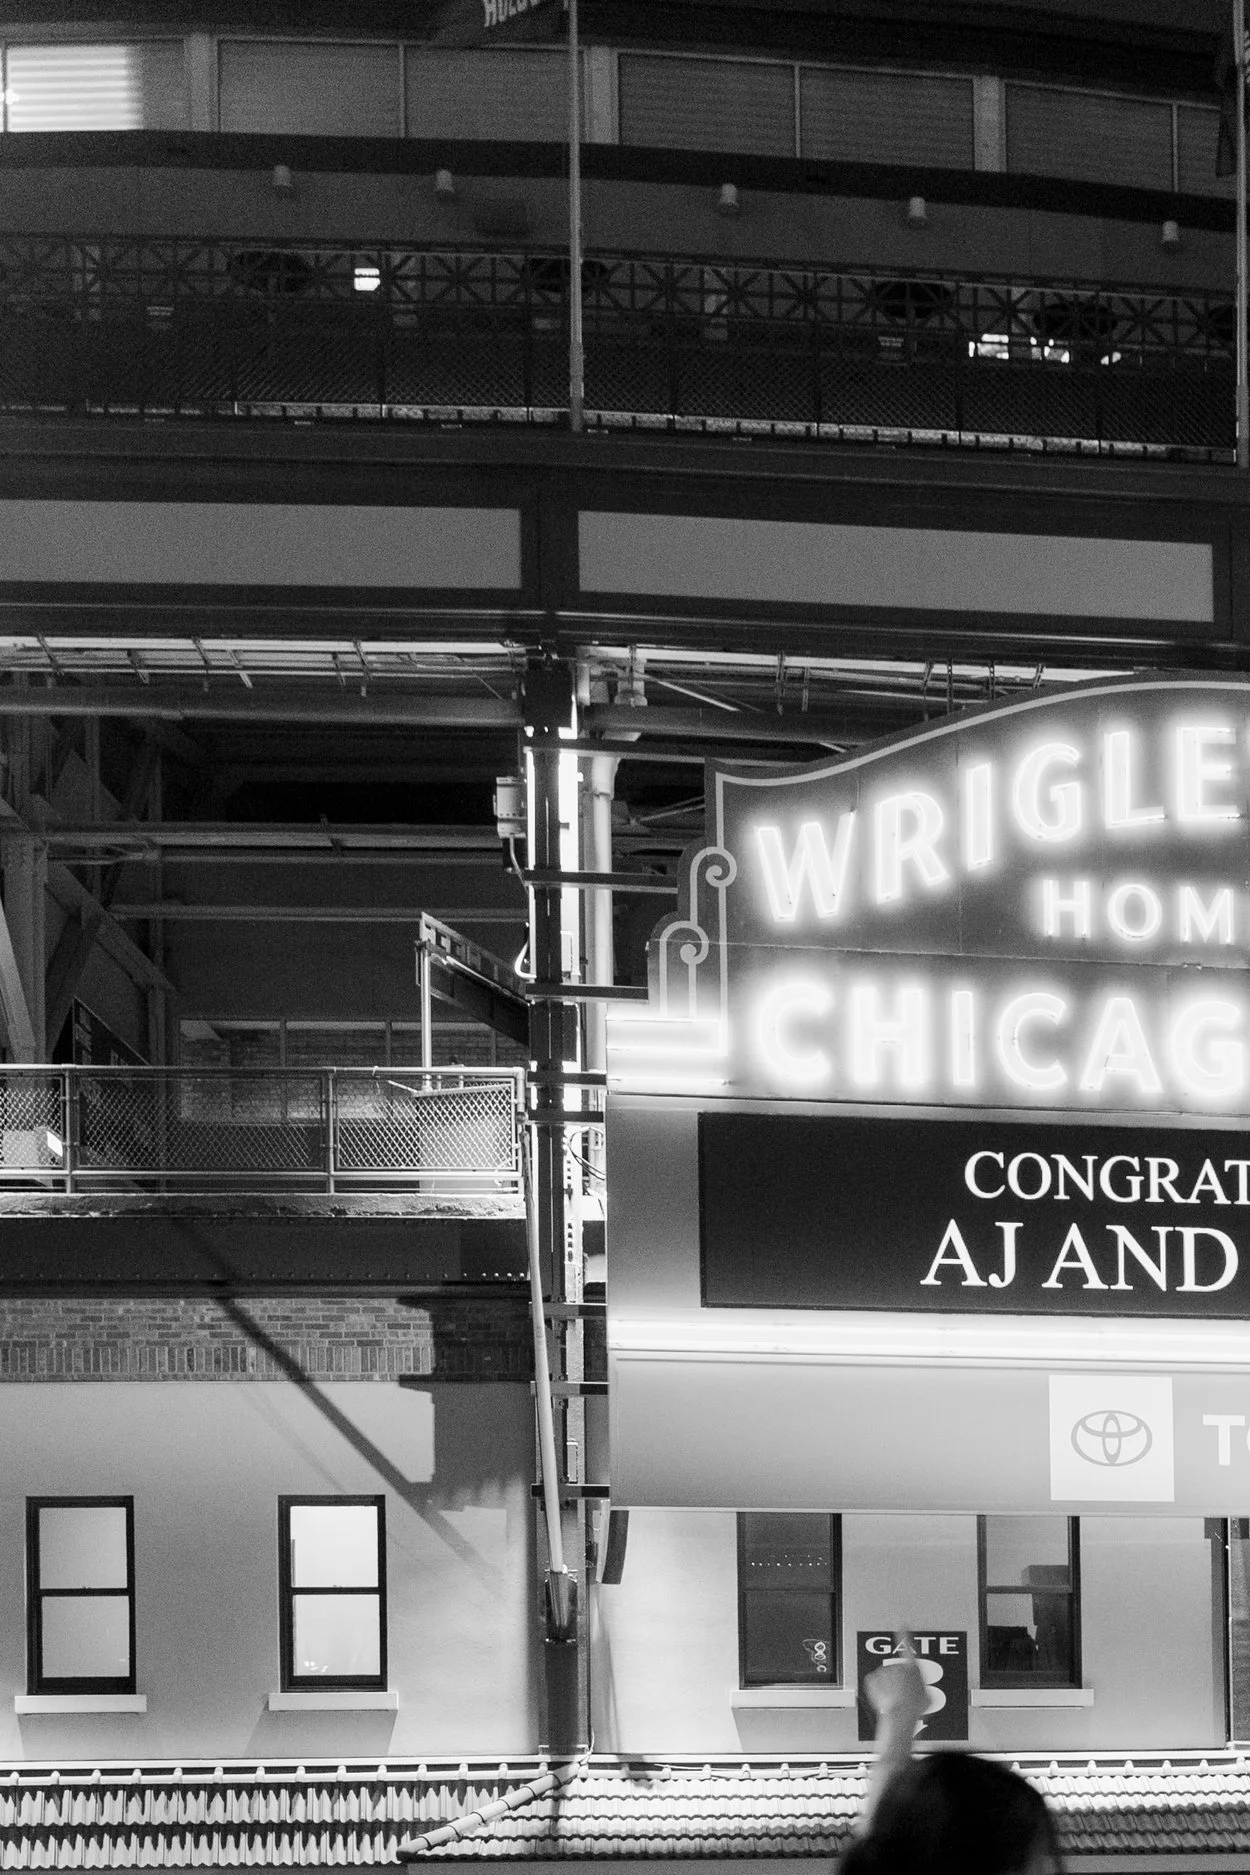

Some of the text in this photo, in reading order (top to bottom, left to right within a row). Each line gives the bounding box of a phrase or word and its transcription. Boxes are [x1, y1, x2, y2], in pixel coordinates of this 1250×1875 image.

[920, 1219, 1024, 1288] AJ
[1042, 1222, 1239, 1293] AND
[865, 1636, 959, 1654] GATE
